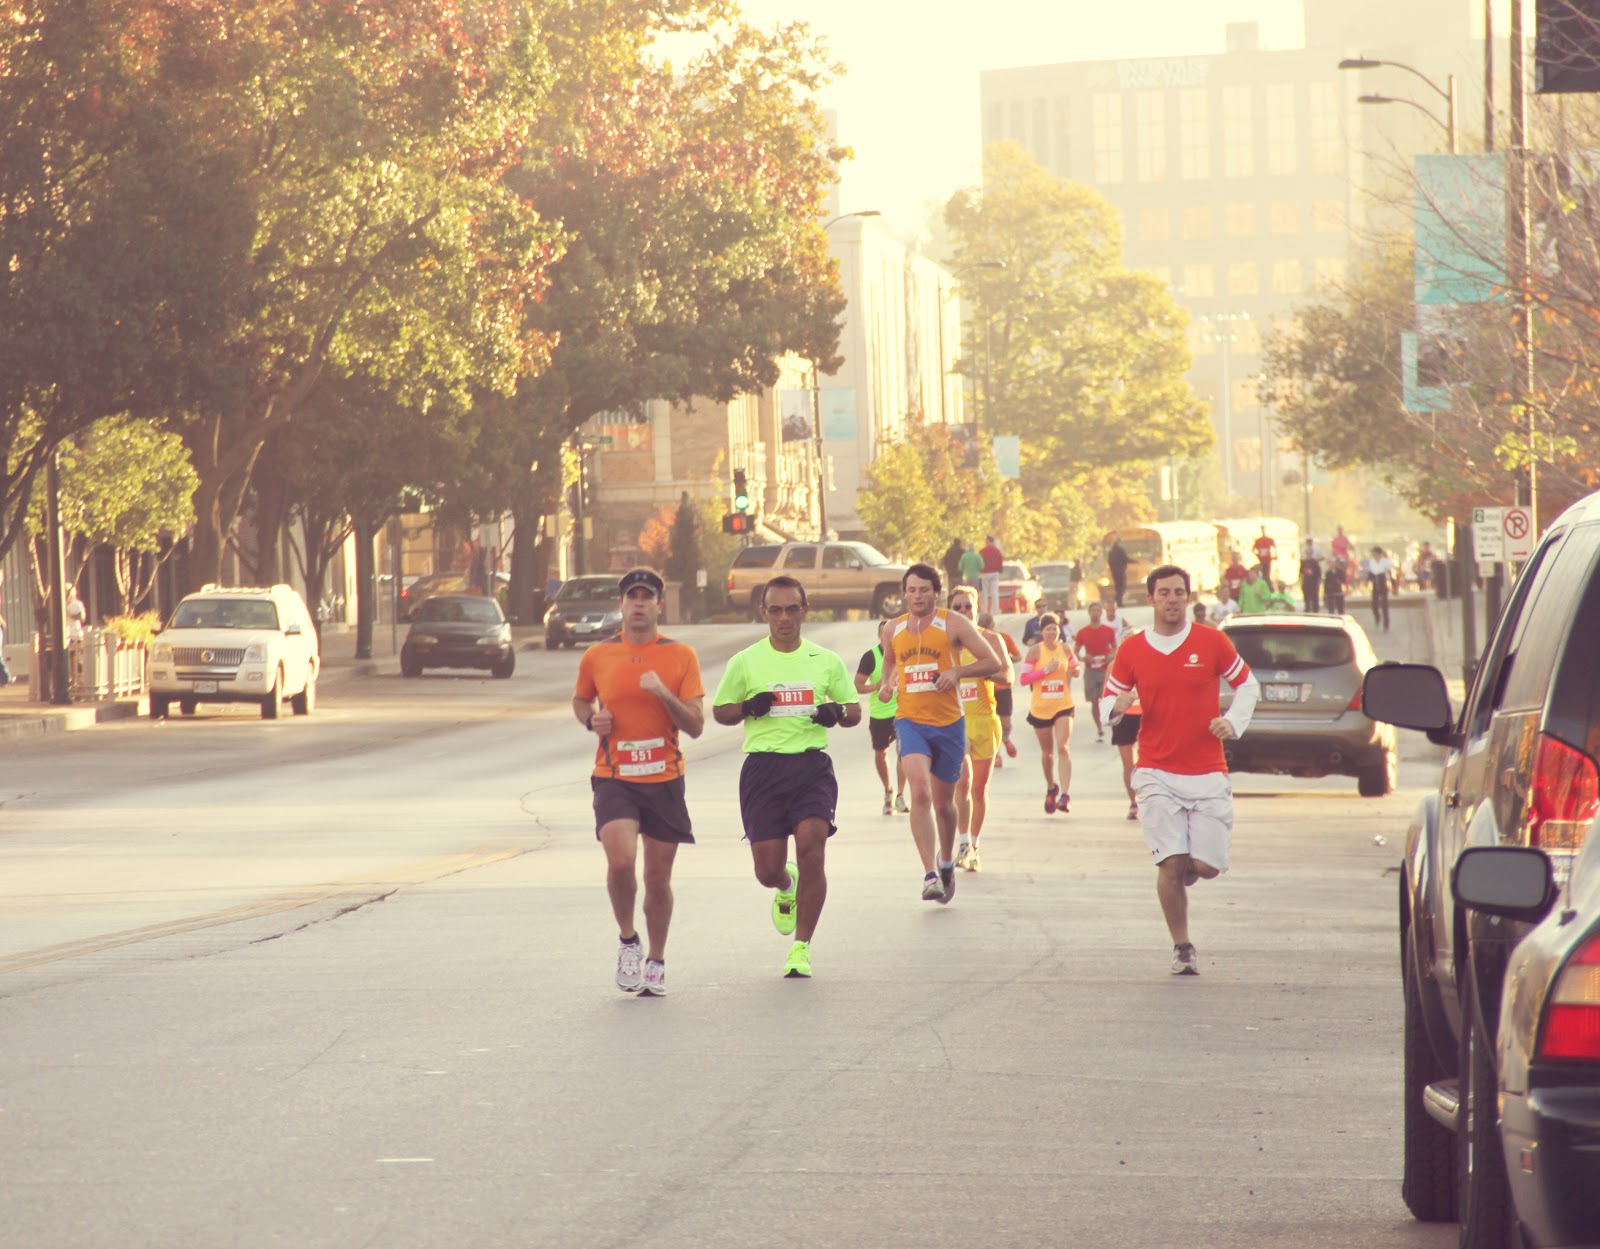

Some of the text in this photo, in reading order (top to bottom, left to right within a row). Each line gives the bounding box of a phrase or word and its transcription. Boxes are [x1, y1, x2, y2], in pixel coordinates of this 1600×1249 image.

[912, 671, 929, 681] 844
[780, 691, 803, 702] 1811
[631, 749, 652, 762] 551
